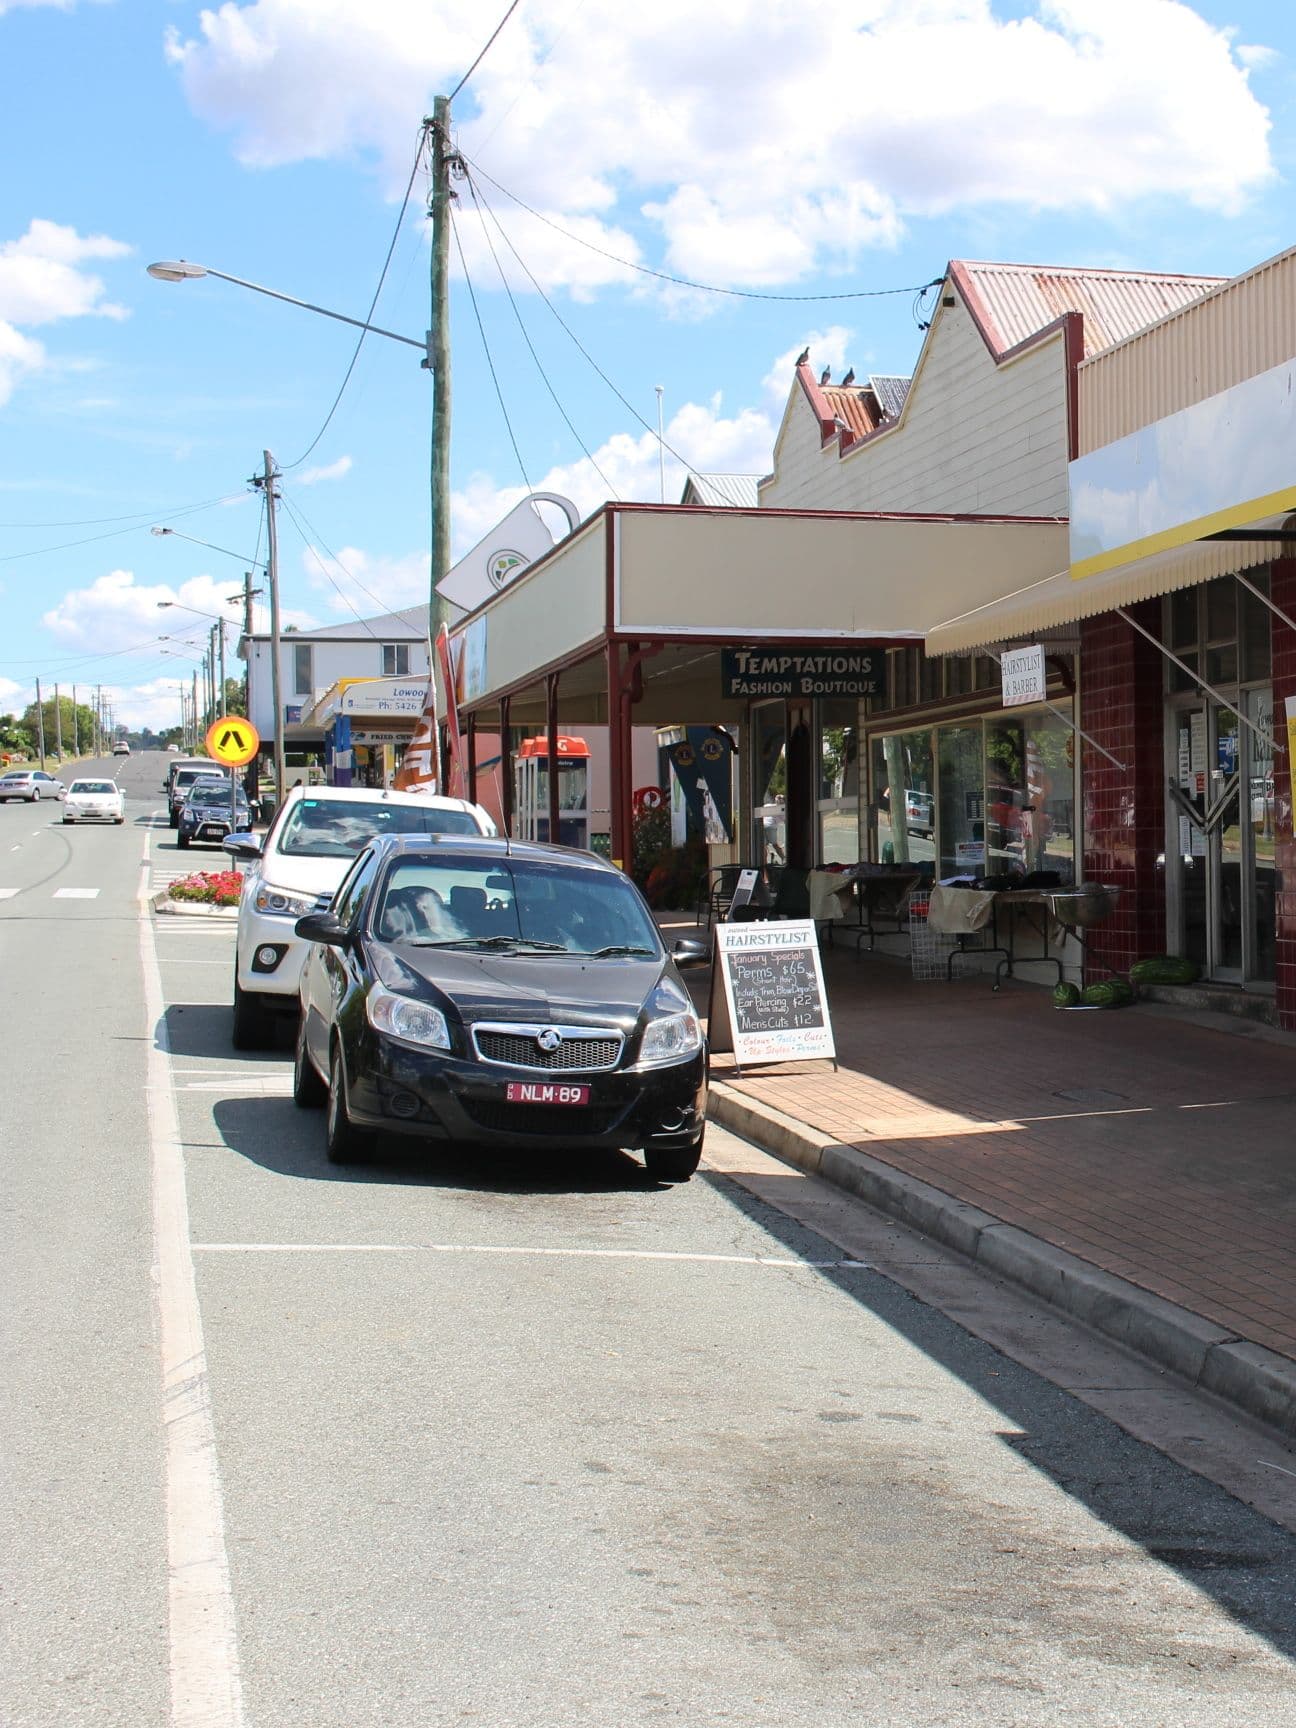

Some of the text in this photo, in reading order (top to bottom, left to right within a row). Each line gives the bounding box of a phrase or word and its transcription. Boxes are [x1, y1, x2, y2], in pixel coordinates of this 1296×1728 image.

[734, 652, 872, 674] TEMPTATIONS
[393, 688, 427, 697] Lowoo
[731, 677, 877, 694] FASHION BOUTIQUE
[726, 932, 809, 946] HAIRSTYLIST
[730, 951, 805, 967] January Specials
[736, 961, 806, 978] Perms $65
[738, 998, 754, 1007] Ear
[793, 995, 812, 1008] $22
